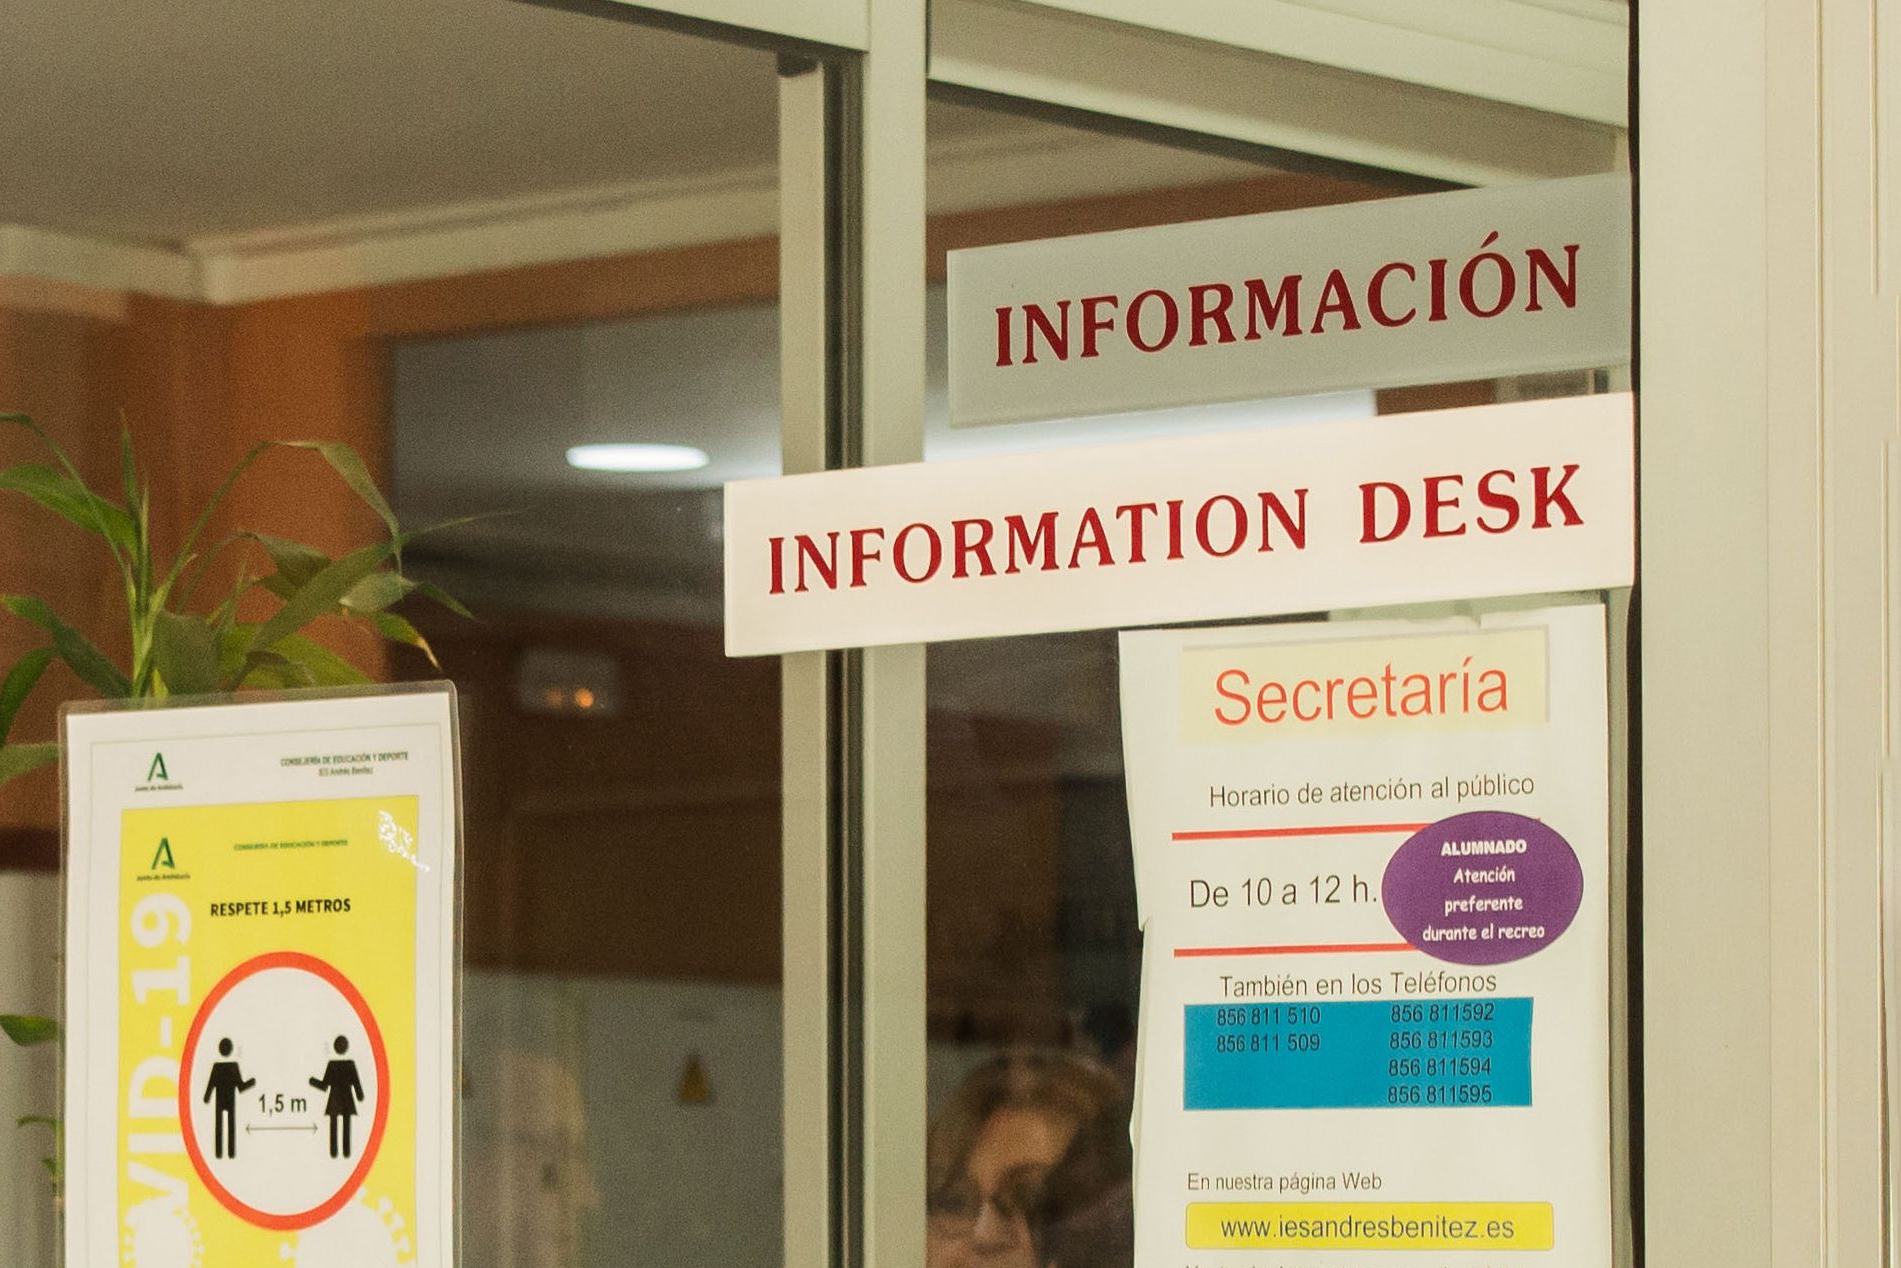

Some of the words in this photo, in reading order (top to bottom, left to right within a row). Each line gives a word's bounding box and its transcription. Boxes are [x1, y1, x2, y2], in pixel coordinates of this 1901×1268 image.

[994, 229, 1581, 367] INFORMACIÓN
[768, 488, 1309, 595] INFORMATION
[1358, 463, 1585, 544] DESK
[1214, 656, 1508, 726] Secretaría
[1210, 784, 1290, 808] Horario
[1297, 782, 1323, 805] de
[1330, 777, 1422, 803] atención
[1431, 775, 1449, 799] al
[1457, 773, 1535, 804] público
[1439, 837, 1529, 859] ALUMNADO
[1453, 865, 1516, 887] Atención
[1190, 879, 1229, 908] De
[1241, 877, 1272, 907] 10
[1281, 883, 1297, 905] a
[1309, 874, 1341, 904] 12
[1353, 873, 1377, 903] h.
[210, 901, 268, 917] RESPETE
[273, 901, 291, 917] 1,5
[295, 896, 353, 913] METROS
[1444, 894, 1524, 917] preferente
[1422, 924, 1479, 944] durante
[1480, 922, 1496, 941] el
[1498, 922, 1547, 941] recreo
[1219, 974, 1308, 998] También
[1316, 978, 1343, 996] en
[1351, 972, 1382, 995] los
[1390, 970, 1497, 994] Teléfonos
[1215, 1006, 1248, 1027] 856
[1249, 1007, 1281, 1026] 811
[1287, 1005, 1322, 1025] 510
[1389, 1002, 1425, 1024] 856
[1428, 1001, 1496, 1023] 811592
[1214, 1034, 1247, 1055] 856
[1249, 1033, 1280, 1052] 811
[1286, 1031, 1322, 1053] 509
[1388, 1030, 1424, 1051] 856
[1427, 1028, 1494, 1049] 811593
[1387, 1058, 1423, 1079] 856
[1425, 1055, 1492, 1077] 811594
[259, 1093, 285, 1116] 1,5
[290, 1098, 307, 1113] m
[1386, 1084, 1422, 1106] 856
[1424, 1084, 1494, 1105] 811595
[1187, 1172, 1210, 1191] En
[1216, 1173, 1273, 1191] nuestra
[1279, 1172, 1336, 1195] página
[1342, 1172, 1382, 1190] Web
[1219, 1214, 1515, 1239] www.iesandresbenitez.es
